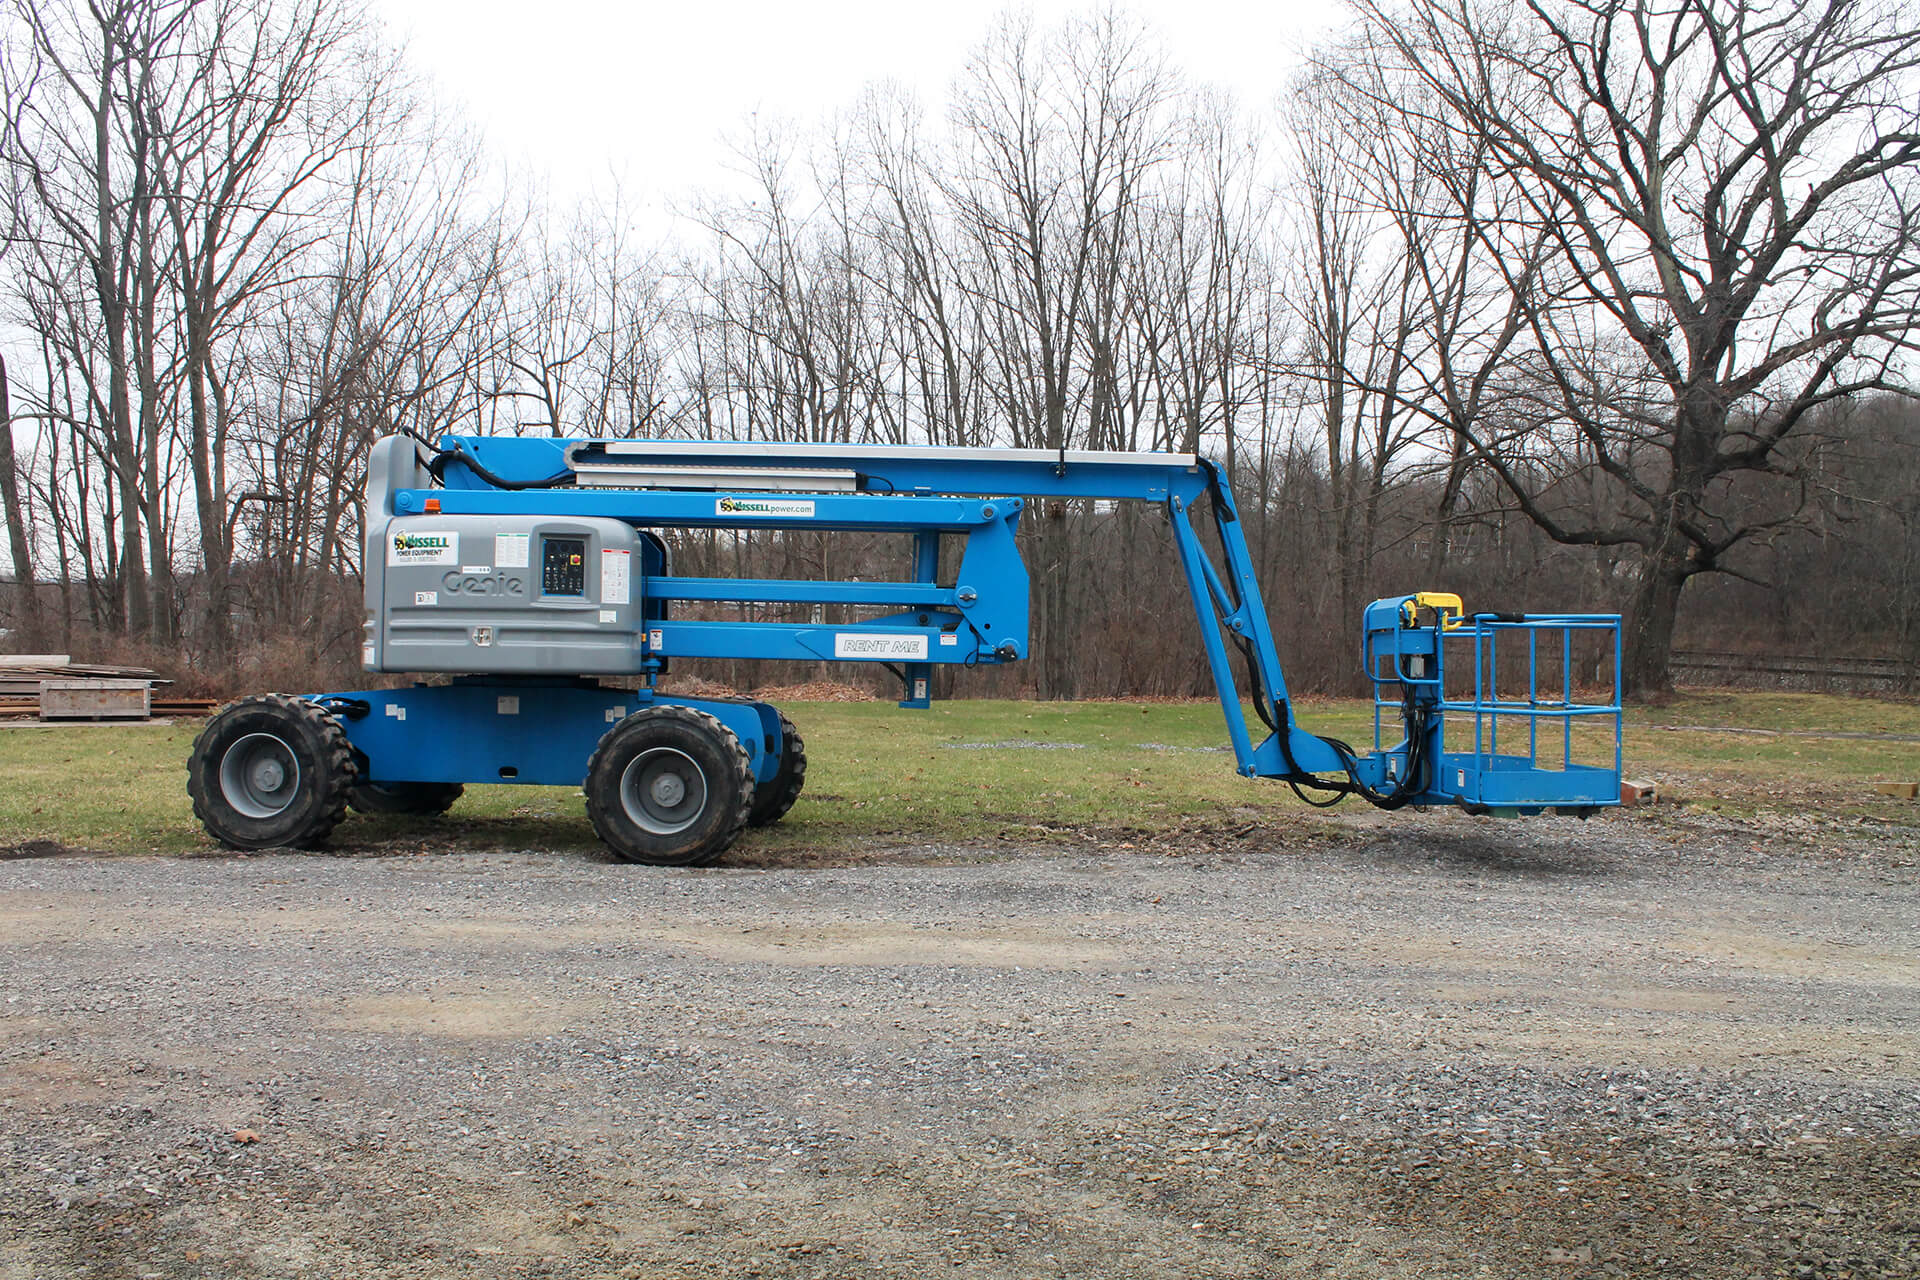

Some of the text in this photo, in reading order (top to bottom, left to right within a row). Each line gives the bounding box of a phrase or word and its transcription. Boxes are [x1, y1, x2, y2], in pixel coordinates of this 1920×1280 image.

[732, 501, 813, 515] USSELLpower.com
[404, 535, 450, 548] USSELL
[396, 549, 443, 557] POWER EQUIPMENT
[441, 571, 523, 597] Genie
[843, 639, 921, 654] RENT ME
